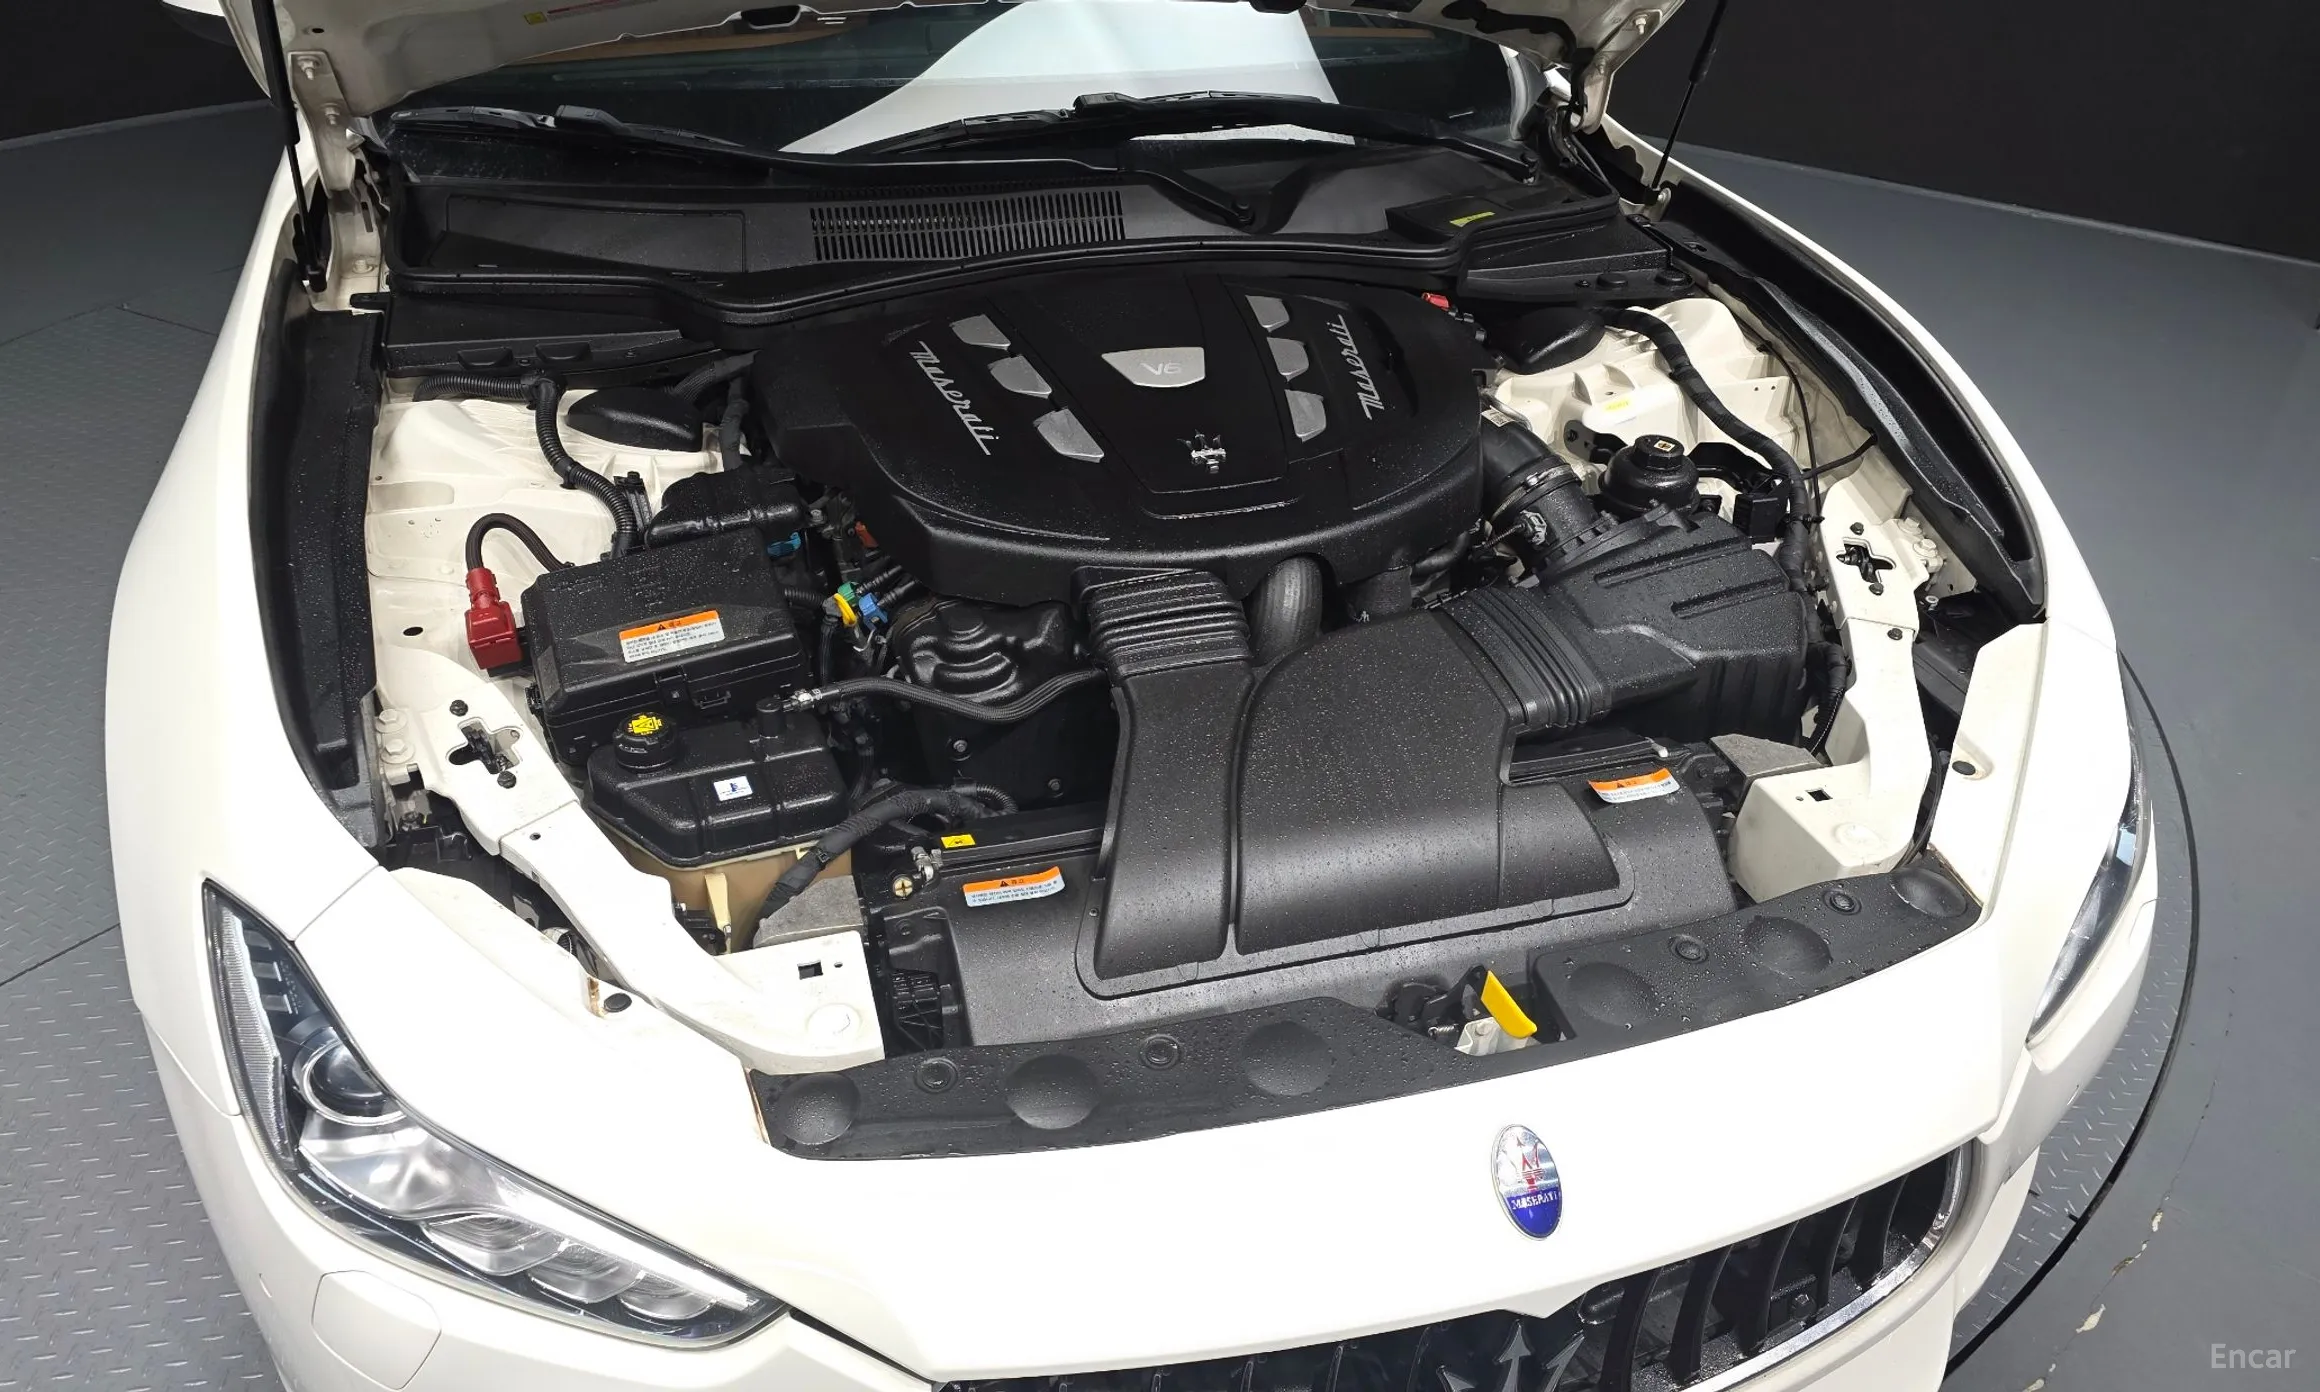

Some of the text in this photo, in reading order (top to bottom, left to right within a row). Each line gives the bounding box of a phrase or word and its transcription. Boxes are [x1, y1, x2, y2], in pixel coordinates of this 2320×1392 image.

[909, 340, 999, 456] Maserati
[1140, 361, 1183, 376] V6
[1326, 313, 1385, 420] Maserati
